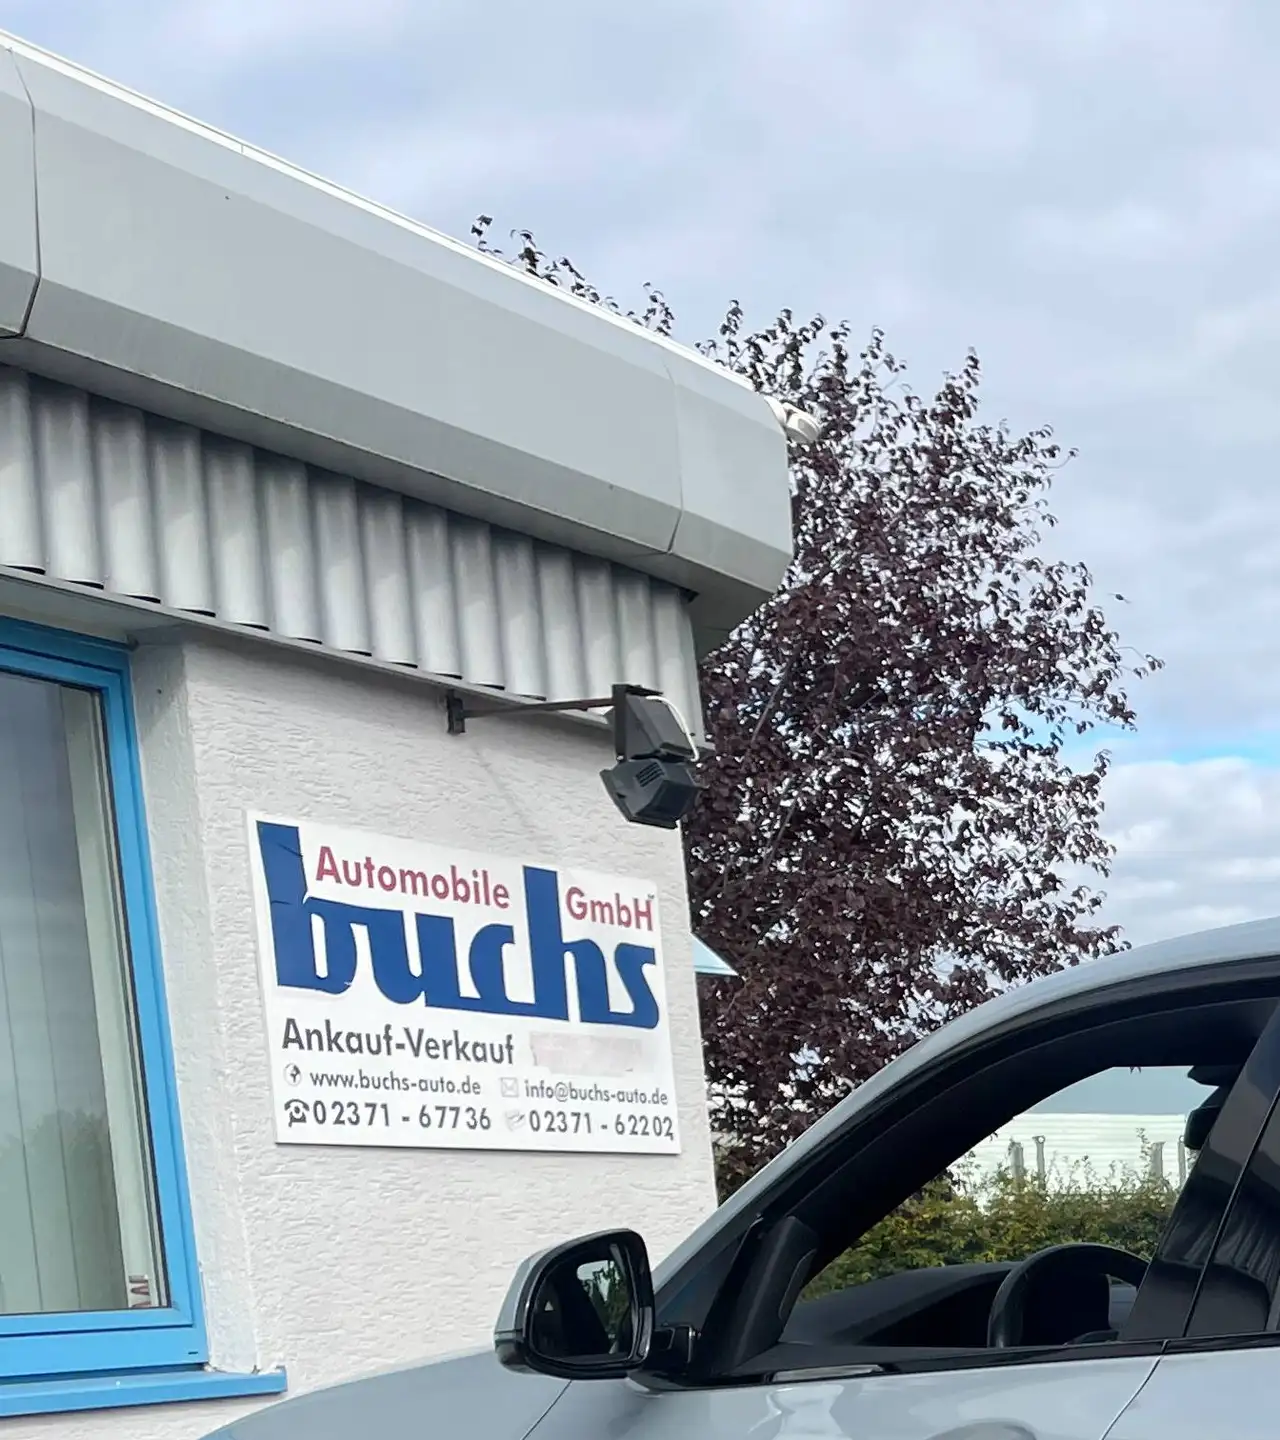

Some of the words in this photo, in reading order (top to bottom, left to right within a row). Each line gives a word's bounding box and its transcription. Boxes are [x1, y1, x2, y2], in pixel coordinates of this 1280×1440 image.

[315, 845, 510, 909] Automobile
[566, 886, 653, 931] GmbH
[256, 820, 660, 1030] buchs
[282, 1017, 514, 1064] Ankauf-Verkauf
[309, 1068, 481, 1095] www.buchs-auto.de
[524, 1079, 668, 1107] info@buchs-auto.de
[313, 1100, 390, 1127] 02371
[418, 1104, 491, 1131] 67736
[529, 1109, 593, 1134] 02371
[614, 1113, 675, 1141] 62202
